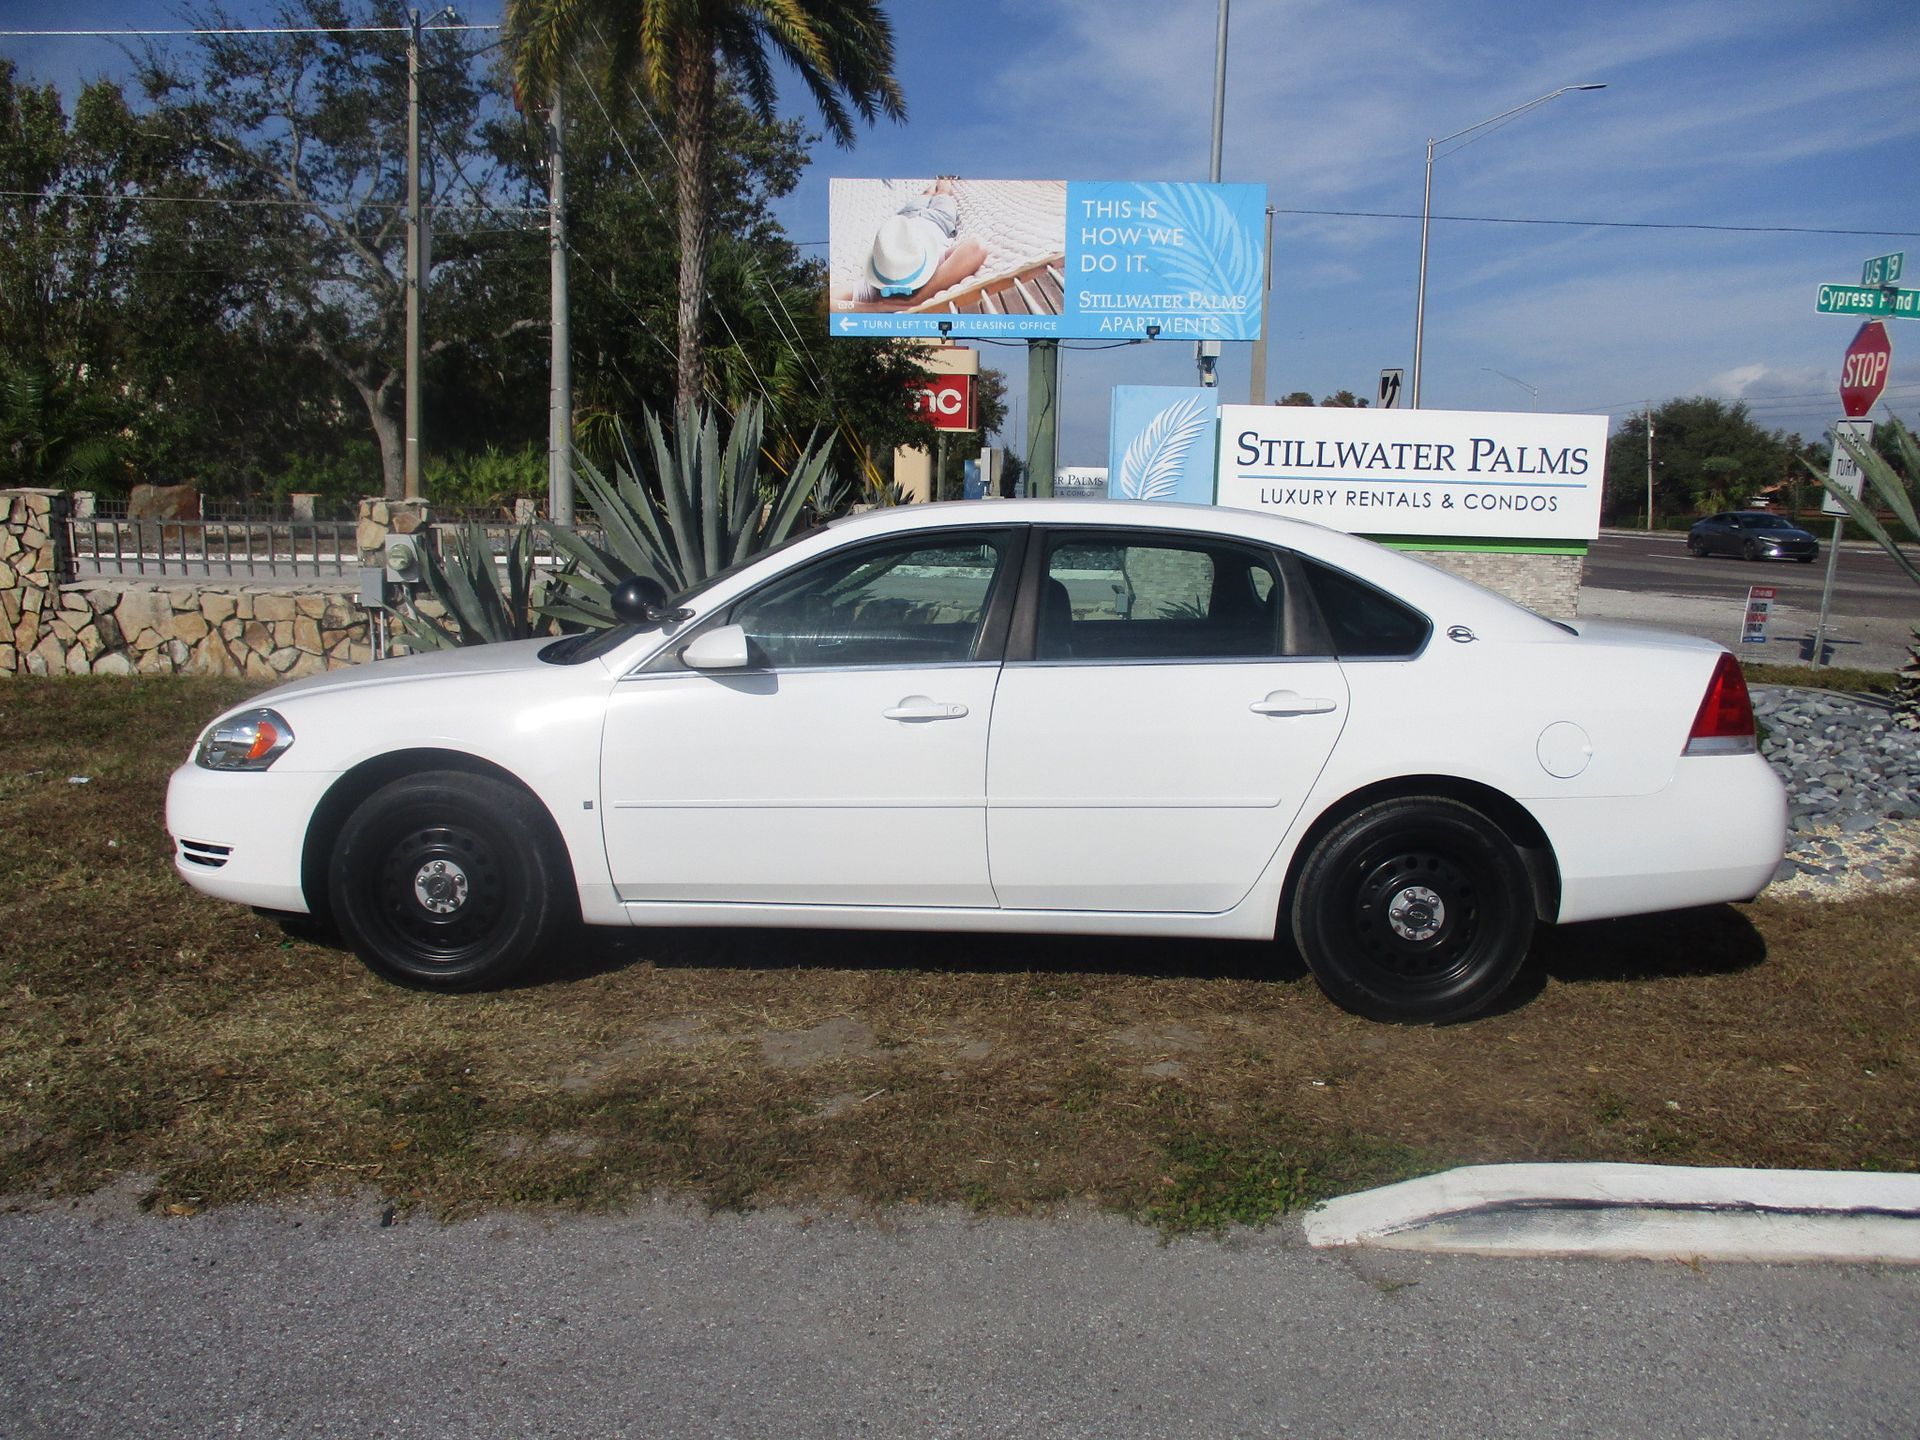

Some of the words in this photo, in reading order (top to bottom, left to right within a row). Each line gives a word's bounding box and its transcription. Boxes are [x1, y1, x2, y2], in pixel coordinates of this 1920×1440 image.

[1081, 200, 1131, 219] THIS
[1140, 200, 1158, 219] IS
[1081, 227, 1142, 246] HOW
[1147, 228, 1185, 246] WE
[1081, 254, 1117, 273] DO
[1126, 255, 1149, 273] IT.
[1865, 260, 1881, 285] US
[1885, 255, 1899, 281] 19
[1079, 290, 1183, 309] STILLWATER
[1188, 291, 1247, 310] PALMS
[1819, 286, 1874, 311] Cypress
[1879, 290, 1913, 311] Pond
[862, 320, 892, 329] TURN
[896, 320, 920, 329] LEFT
[923, 320, 939, 329] TO
[970, 321, 1015, 330] LEASING
[1019, 321, 1057, 331] OFFICE
[1099, 316, 1221, 333] APARTMENTS
[1843, 351, 1887, 388] STOP
[911, 388, 962, 415] nc
[1236, 431, 1456, 471] STILLWATER
[1467, 438, 1589, 475] PALMS
[1836, 458, 1858, 477] TURN
[1068, 474, 1104, 486] PALMS
[1260, 488, 1337, 506] LUXURY
[1346, 491, 1431, 508] RENTALS
[1441, 493, 1454, 509] &
[1463, 493, 1558, 512] CONDOS
